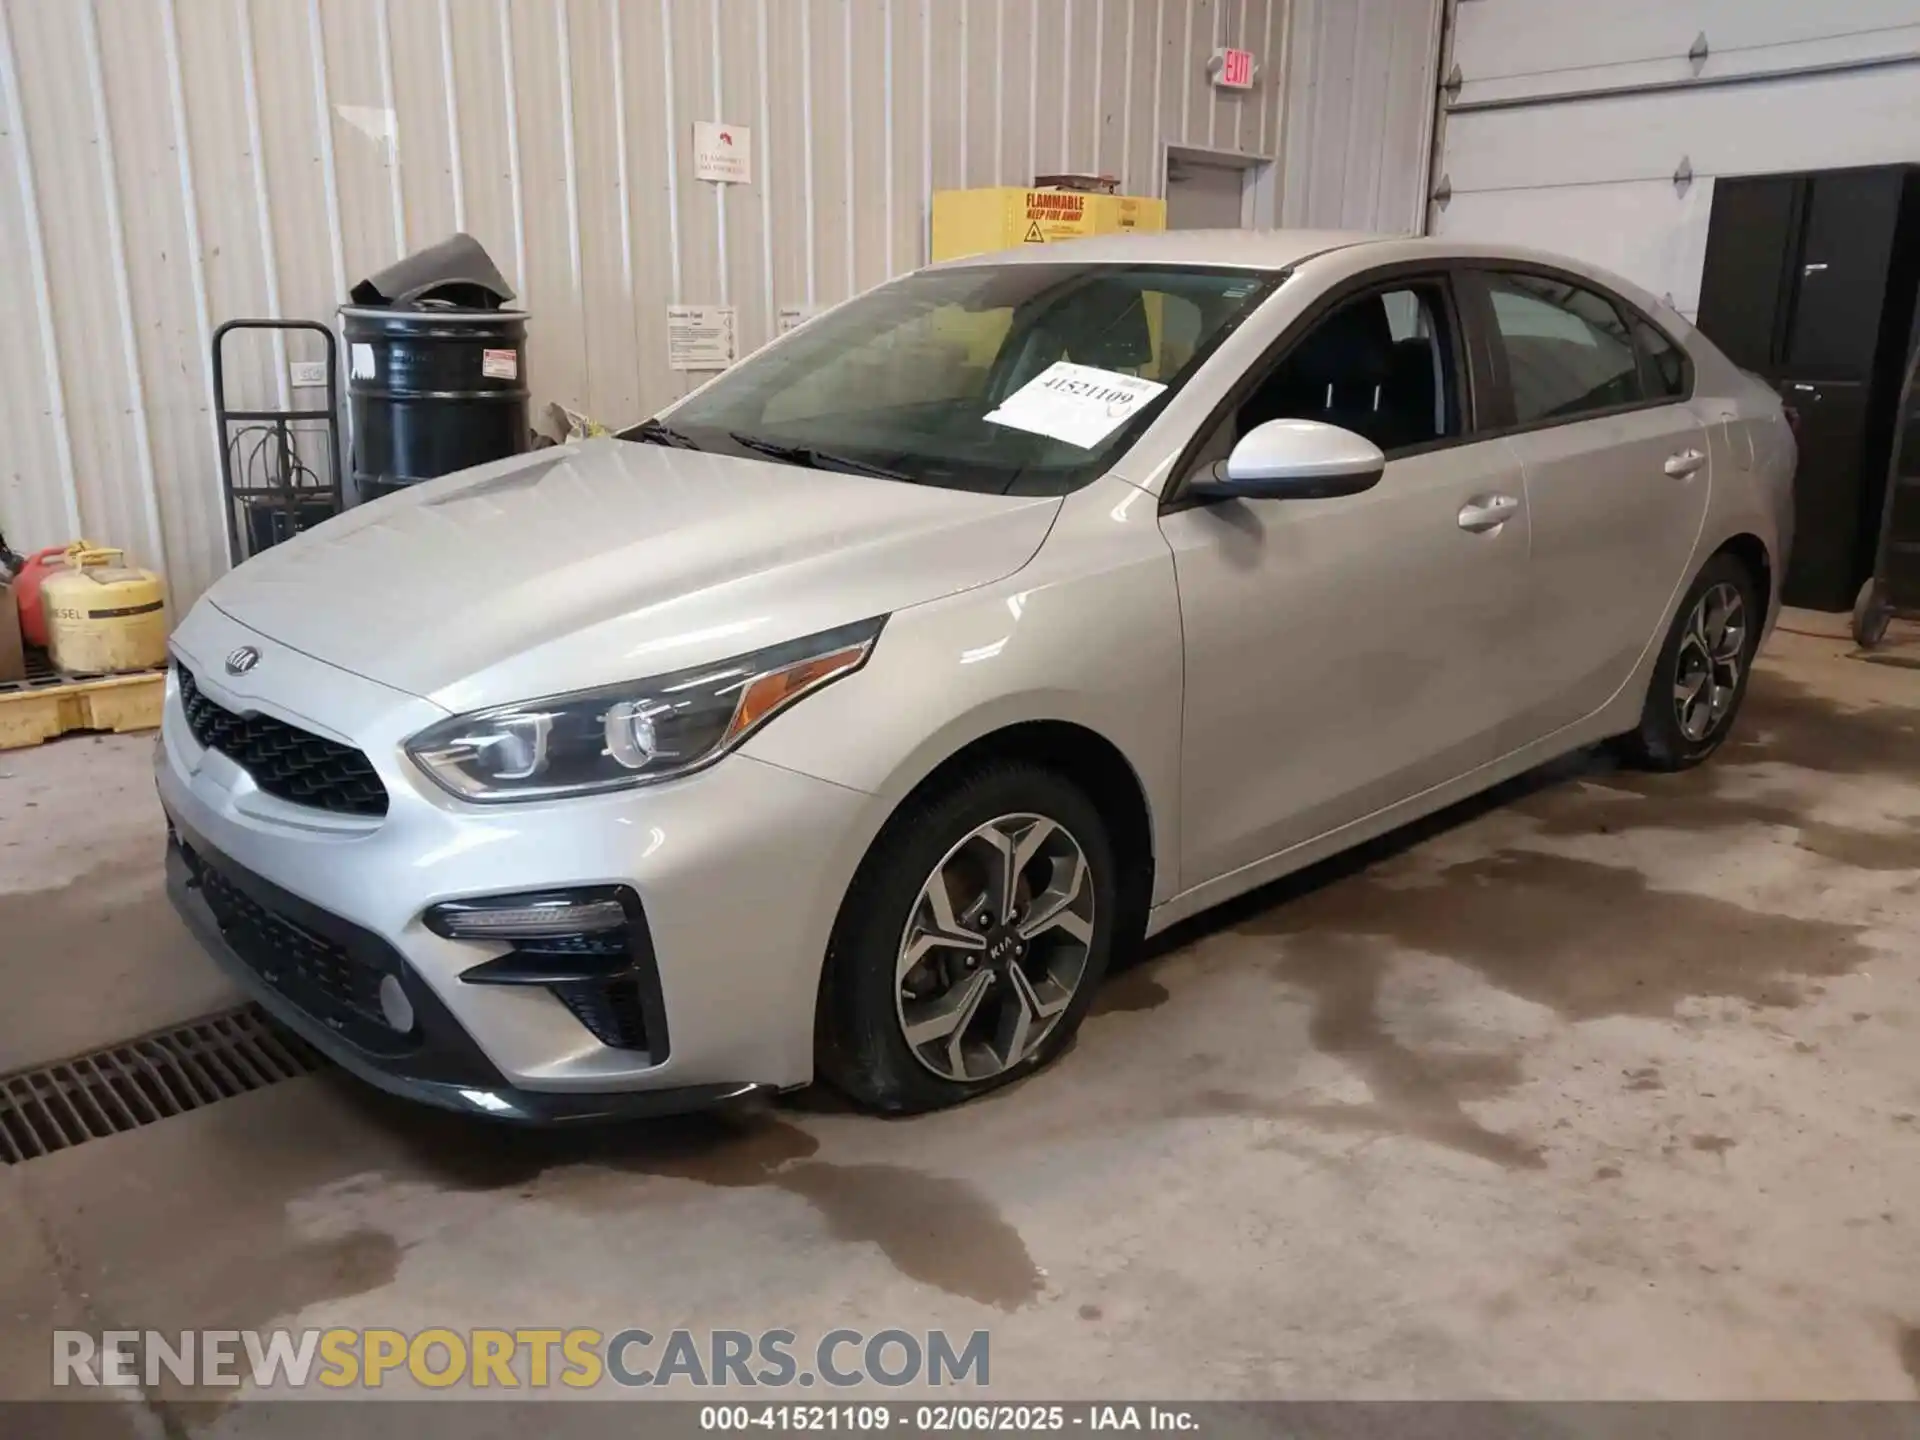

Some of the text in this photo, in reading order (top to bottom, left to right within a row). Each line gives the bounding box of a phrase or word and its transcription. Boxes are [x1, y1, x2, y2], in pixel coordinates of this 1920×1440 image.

[1226, 50, 1250, 84] EXIT
[1026, 193, 1084, 210] FLAMMABLE
[1026, 208, 1045, 220] KEEP
[1045, 209, 1062, 221] FIRE
[1043, 377, 1135, 404] 41521109
[229, 649, 255, 670] KIA
[990, 936, 1012, 960] KIA
